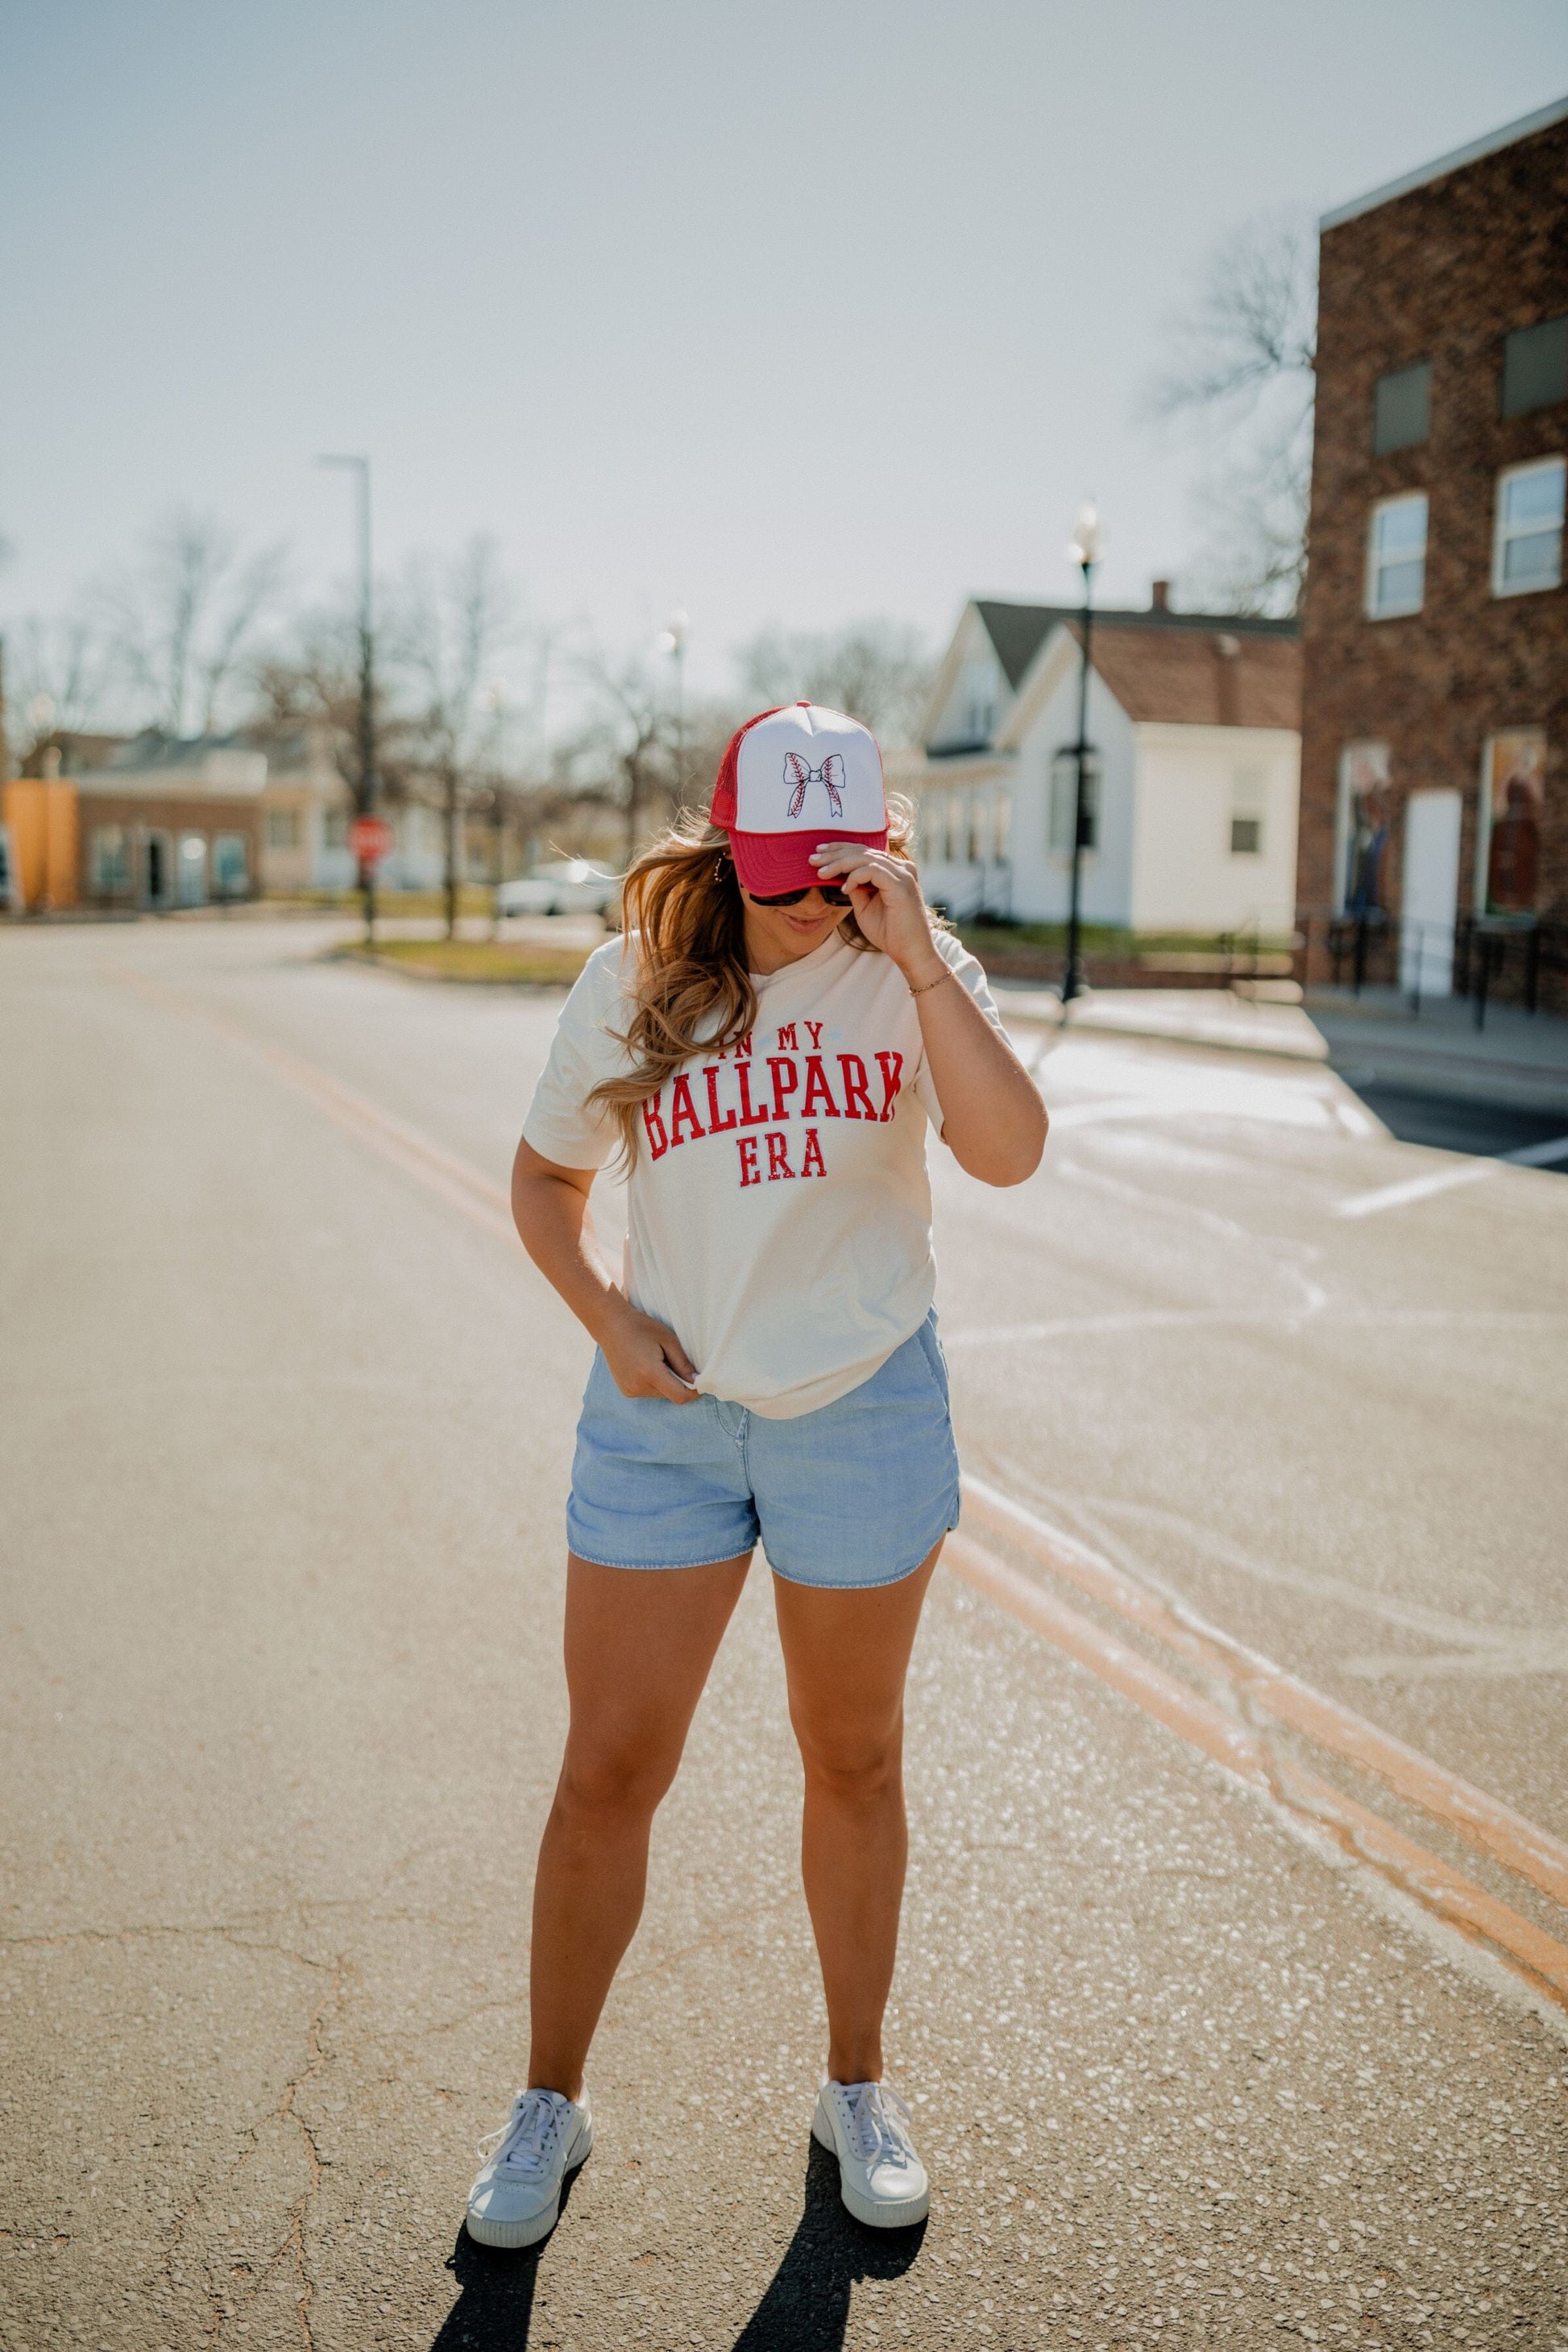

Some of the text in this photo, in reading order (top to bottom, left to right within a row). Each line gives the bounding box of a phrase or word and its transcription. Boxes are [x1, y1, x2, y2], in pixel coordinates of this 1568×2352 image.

[778, 1021, 823, 1051] MY
[643, 1051, 903, 1161] BALLPARK
[736, 1129, 827, 1188] ERA
